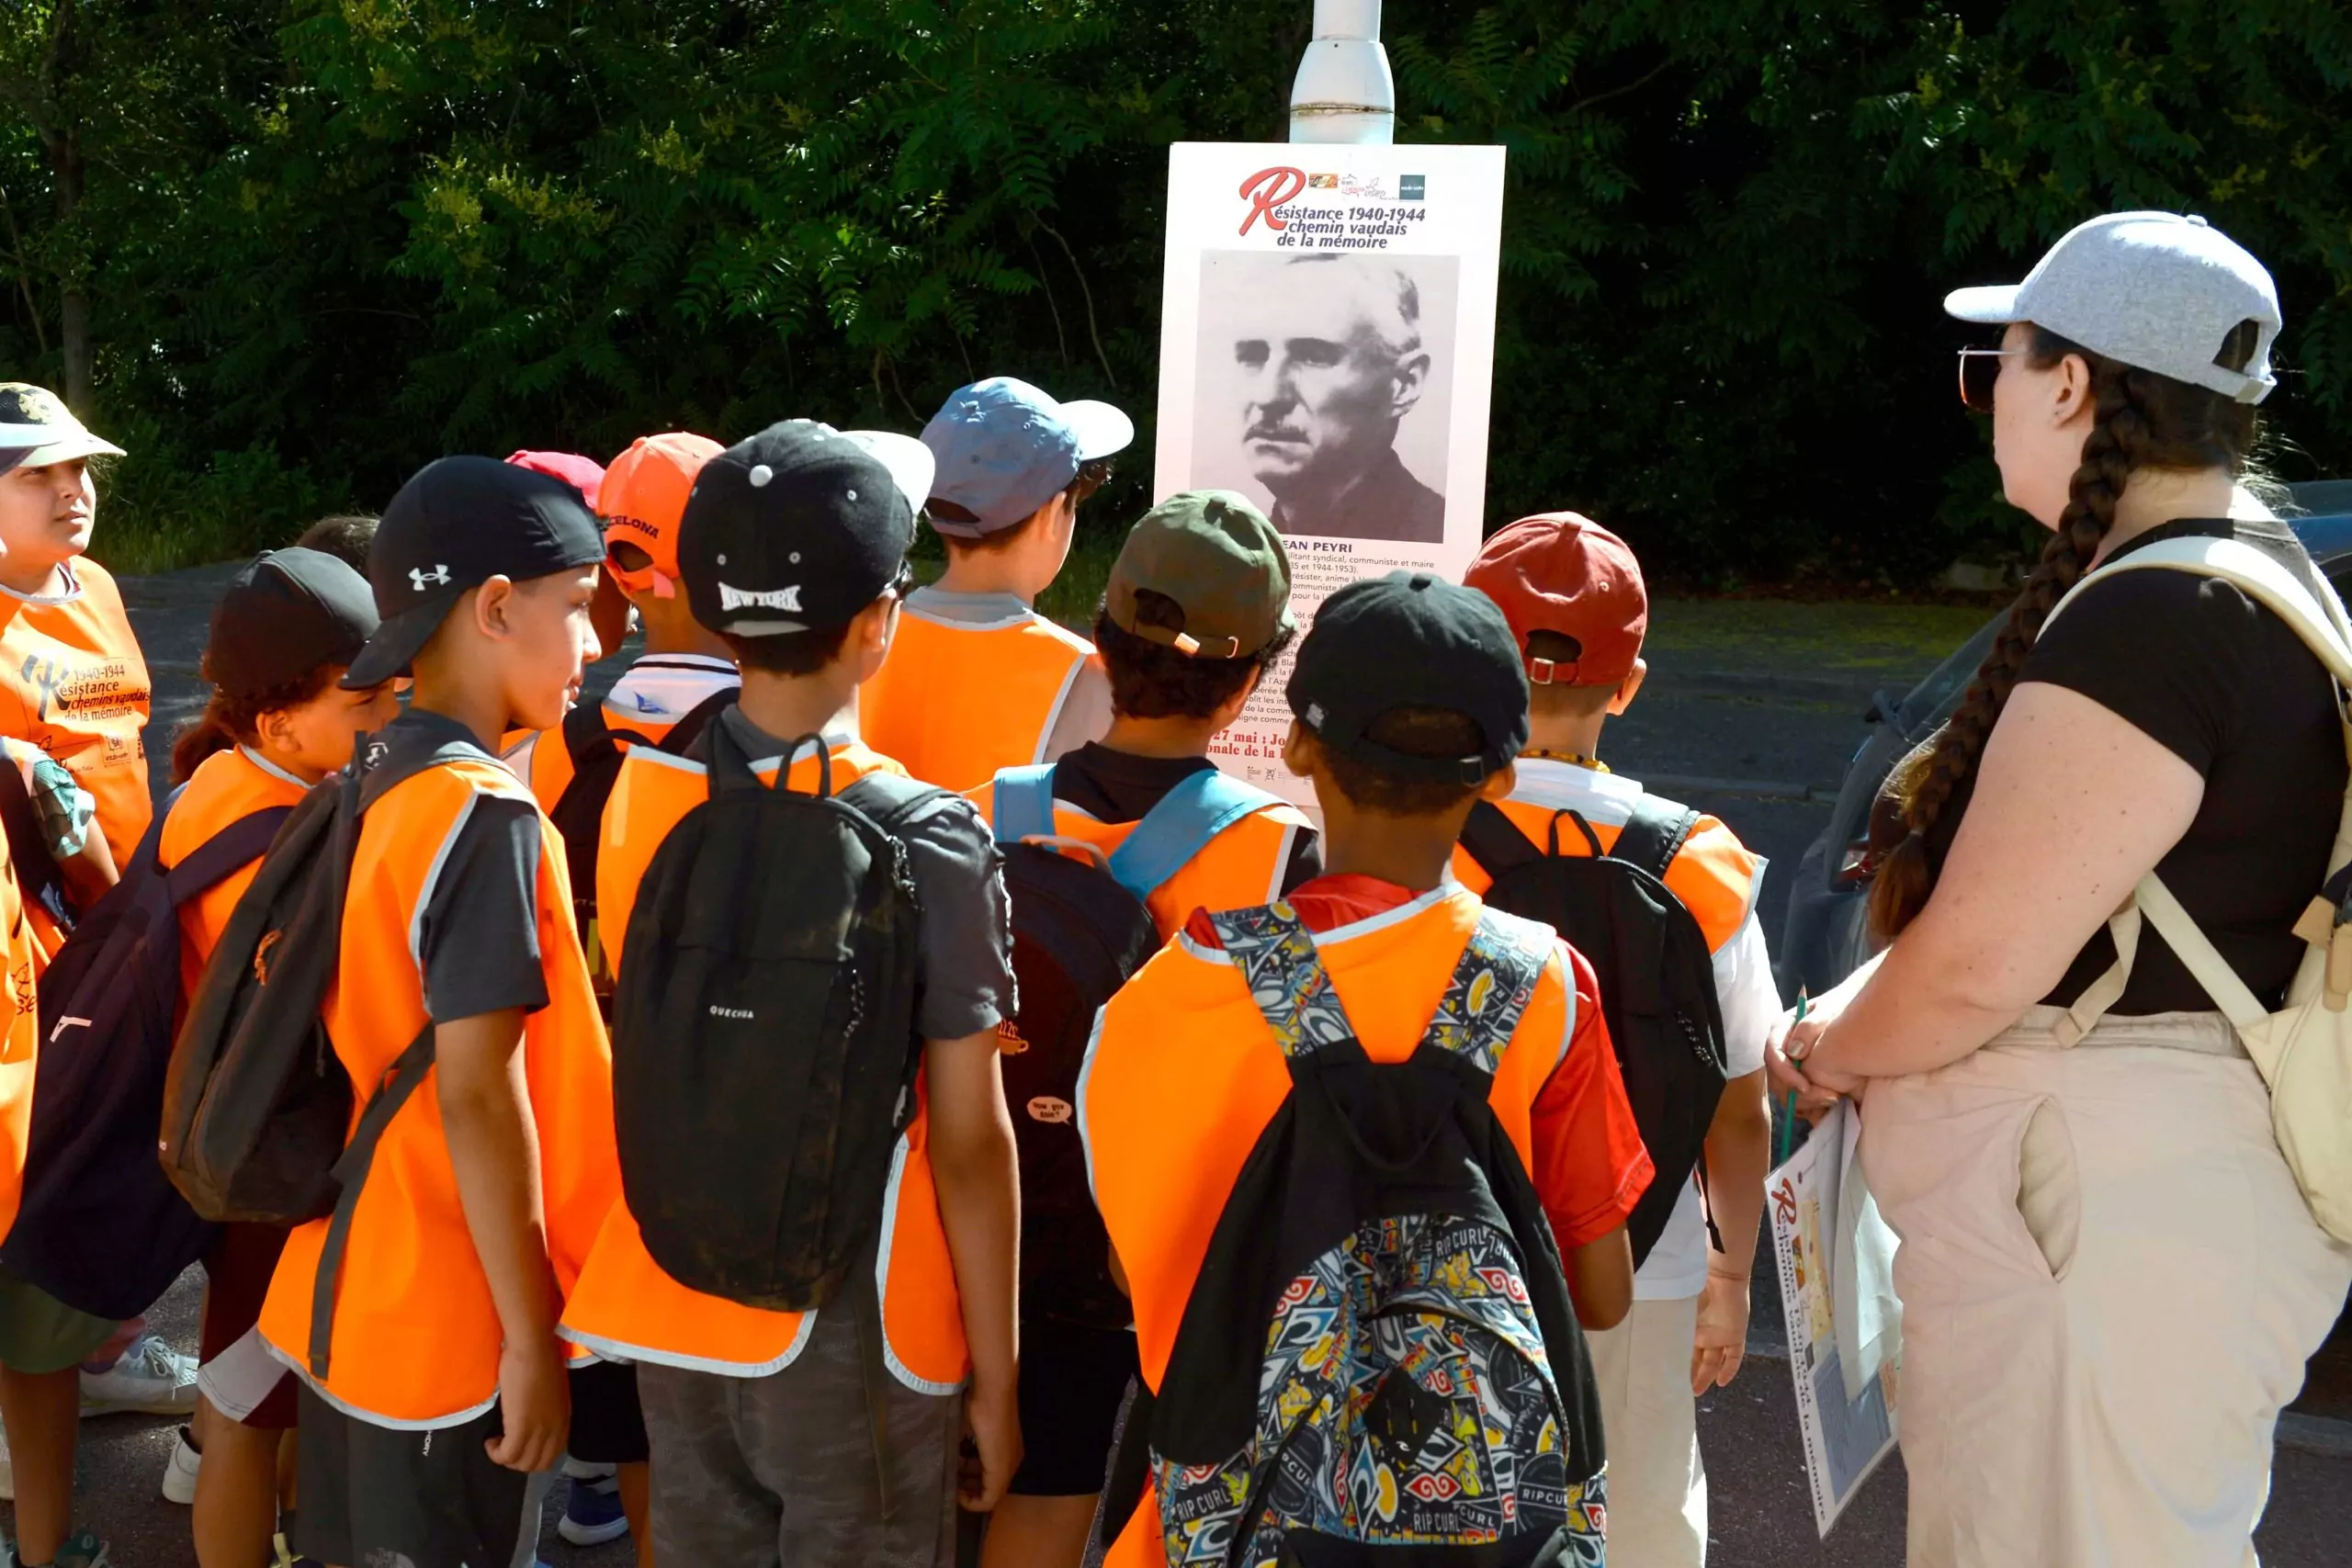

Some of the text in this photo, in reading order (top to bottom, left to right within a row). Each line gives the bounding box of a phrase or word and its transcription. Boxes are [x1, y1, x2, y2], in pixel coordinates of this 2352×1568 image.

[1239, 166, 1426, 237] Résistance 1940-1944
[1288, 220, 1408, 235] chemin vaudais
[1277, 232, 1388, 249] de la mémoire
[1283, 540, 1353, 553] EAN PEYRI
[1288, 552, 1310, 560] ilitant
[1313, 554, 1347, 564] syndical,
[1349, 557, 1398, 567] communiste
[1411, 559, 1435, 569] maire
[1292, 573, 1323, 582] résister,
[1293, 582, 1337, 592] ommuniste
[753, 584, 803, 613] YORK
[1313, 592, 1320, 600] la
[71, 692, 113, 710] chemins
[1245, 705, 1255, 713] de
[91, 705, 132, 721] mémoire
[1260, 716, 1290, 725] comme
[1213, 729, 1230, 741] 27
[1234, 731, 1258, 744] mai
[1270, 733, 1287, 747] Jo
[1207, 742, 1239, 755] onale
[1244, 744, 1260, 757] de
[1263, 746, 1276, 759] la
[1453, 1228, 1486, 1248] CURL
[1176, 1486, 1231, 1522] RIP CURL
[1412, 1512, 1461, 1532] RIP CURL
